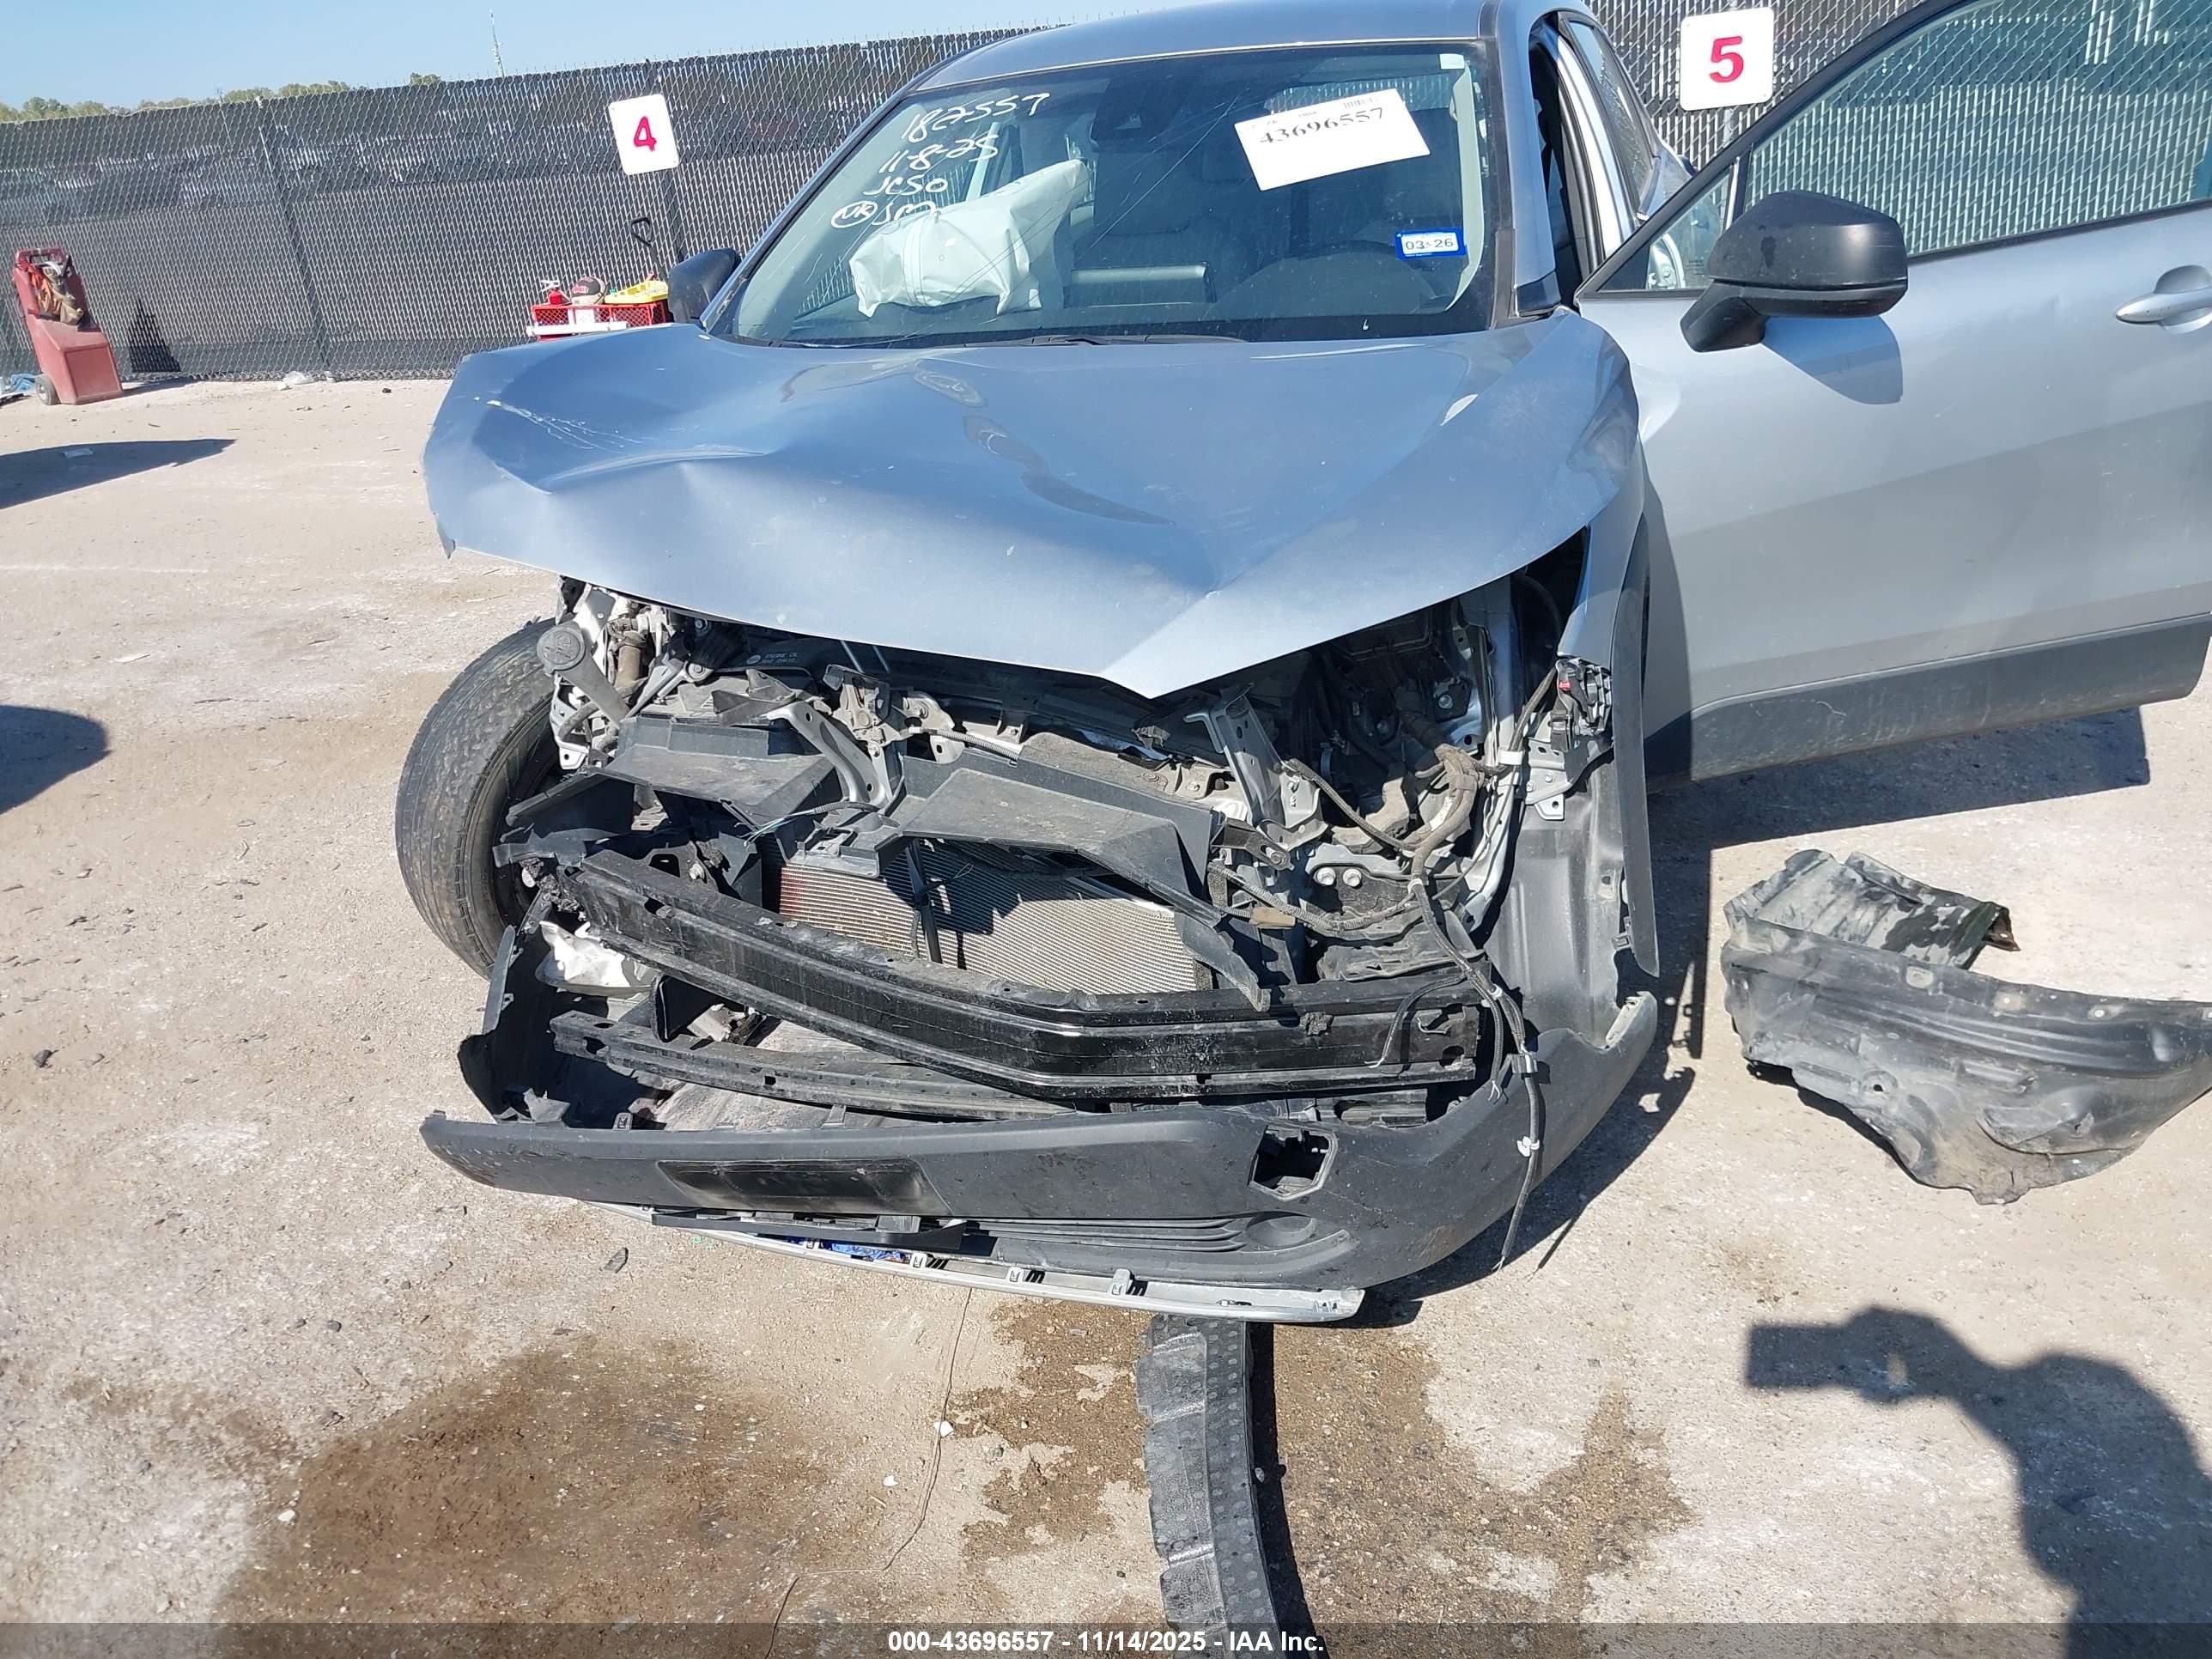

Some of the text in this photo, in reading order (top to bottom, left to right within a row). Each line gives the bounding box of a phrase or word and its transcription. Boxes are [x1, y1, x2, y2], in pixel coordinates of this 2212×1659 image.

[1710, 36, 1744, 83] 5
[634, 116, 657, 151] 4
[1259, 106, 1383, 143] 43696557
